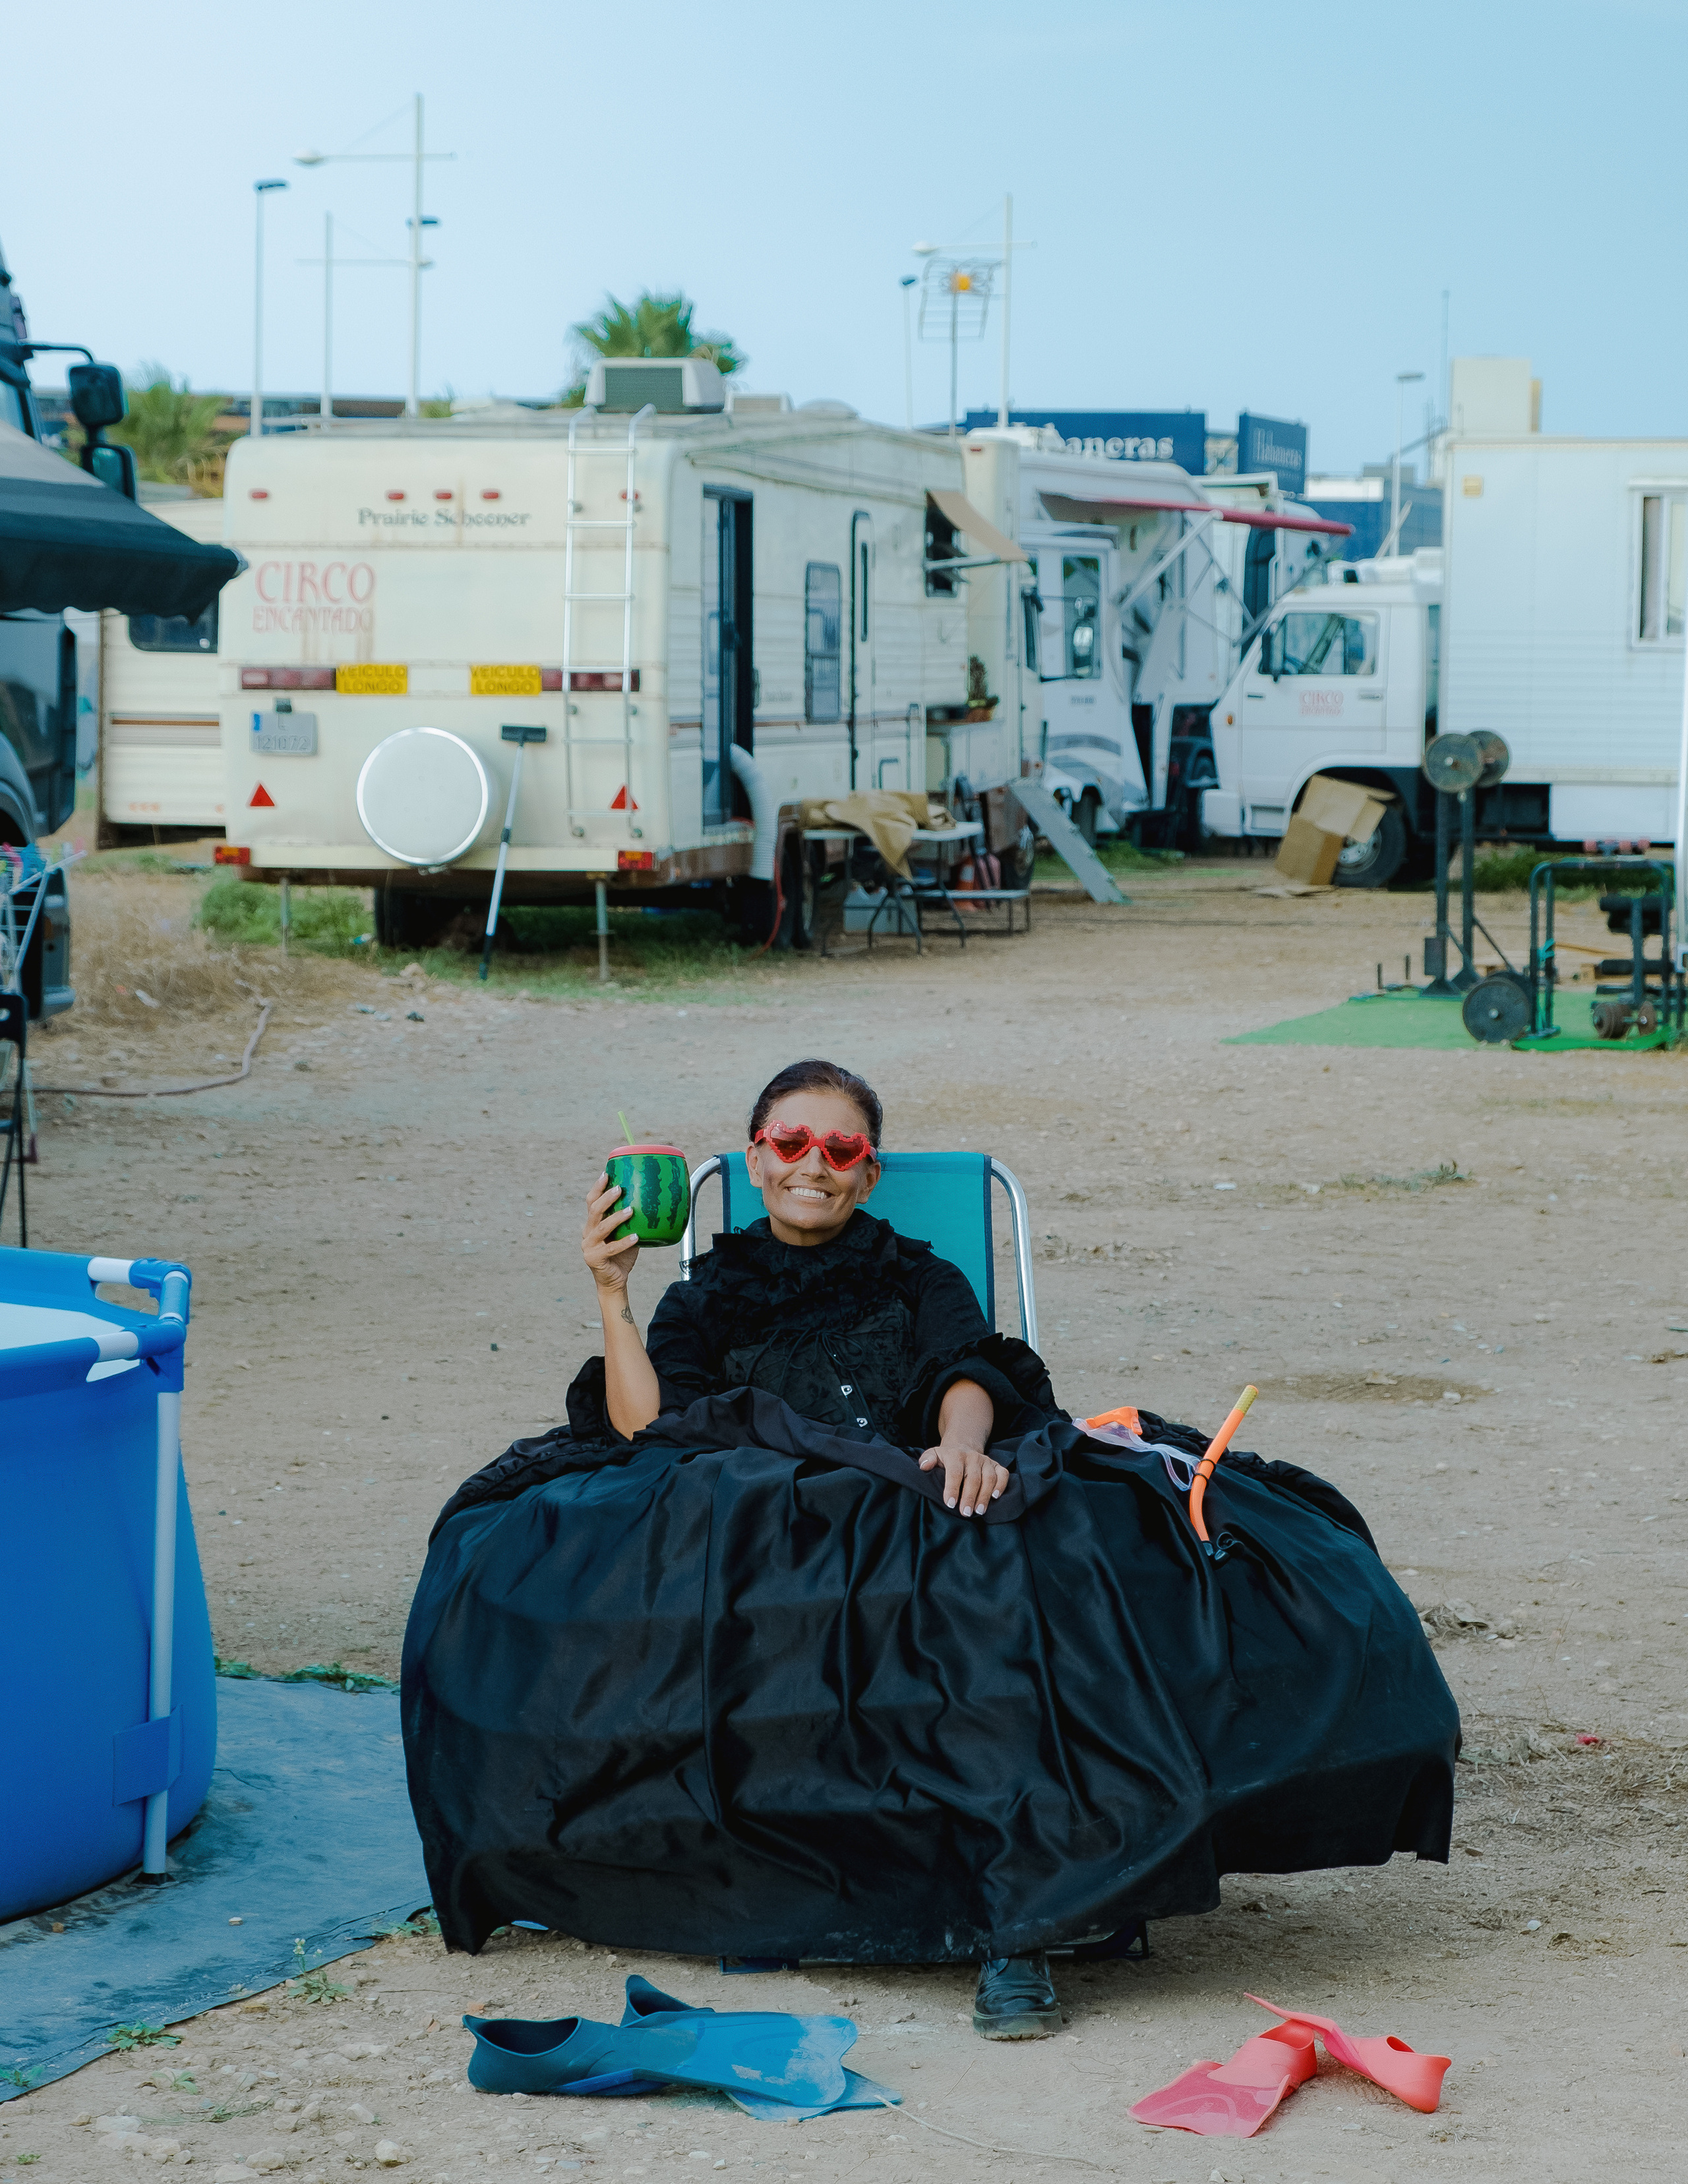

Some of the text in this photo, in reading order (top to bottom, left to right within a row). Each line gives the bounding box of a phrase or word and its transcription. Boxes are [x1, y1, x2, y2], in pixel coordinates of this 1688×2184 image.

[357, 508, 530, 526] Prairie Schooner
[255, 561, 375, 603] CIRCO
[1299, 690, 1344, 707] CIRCO
